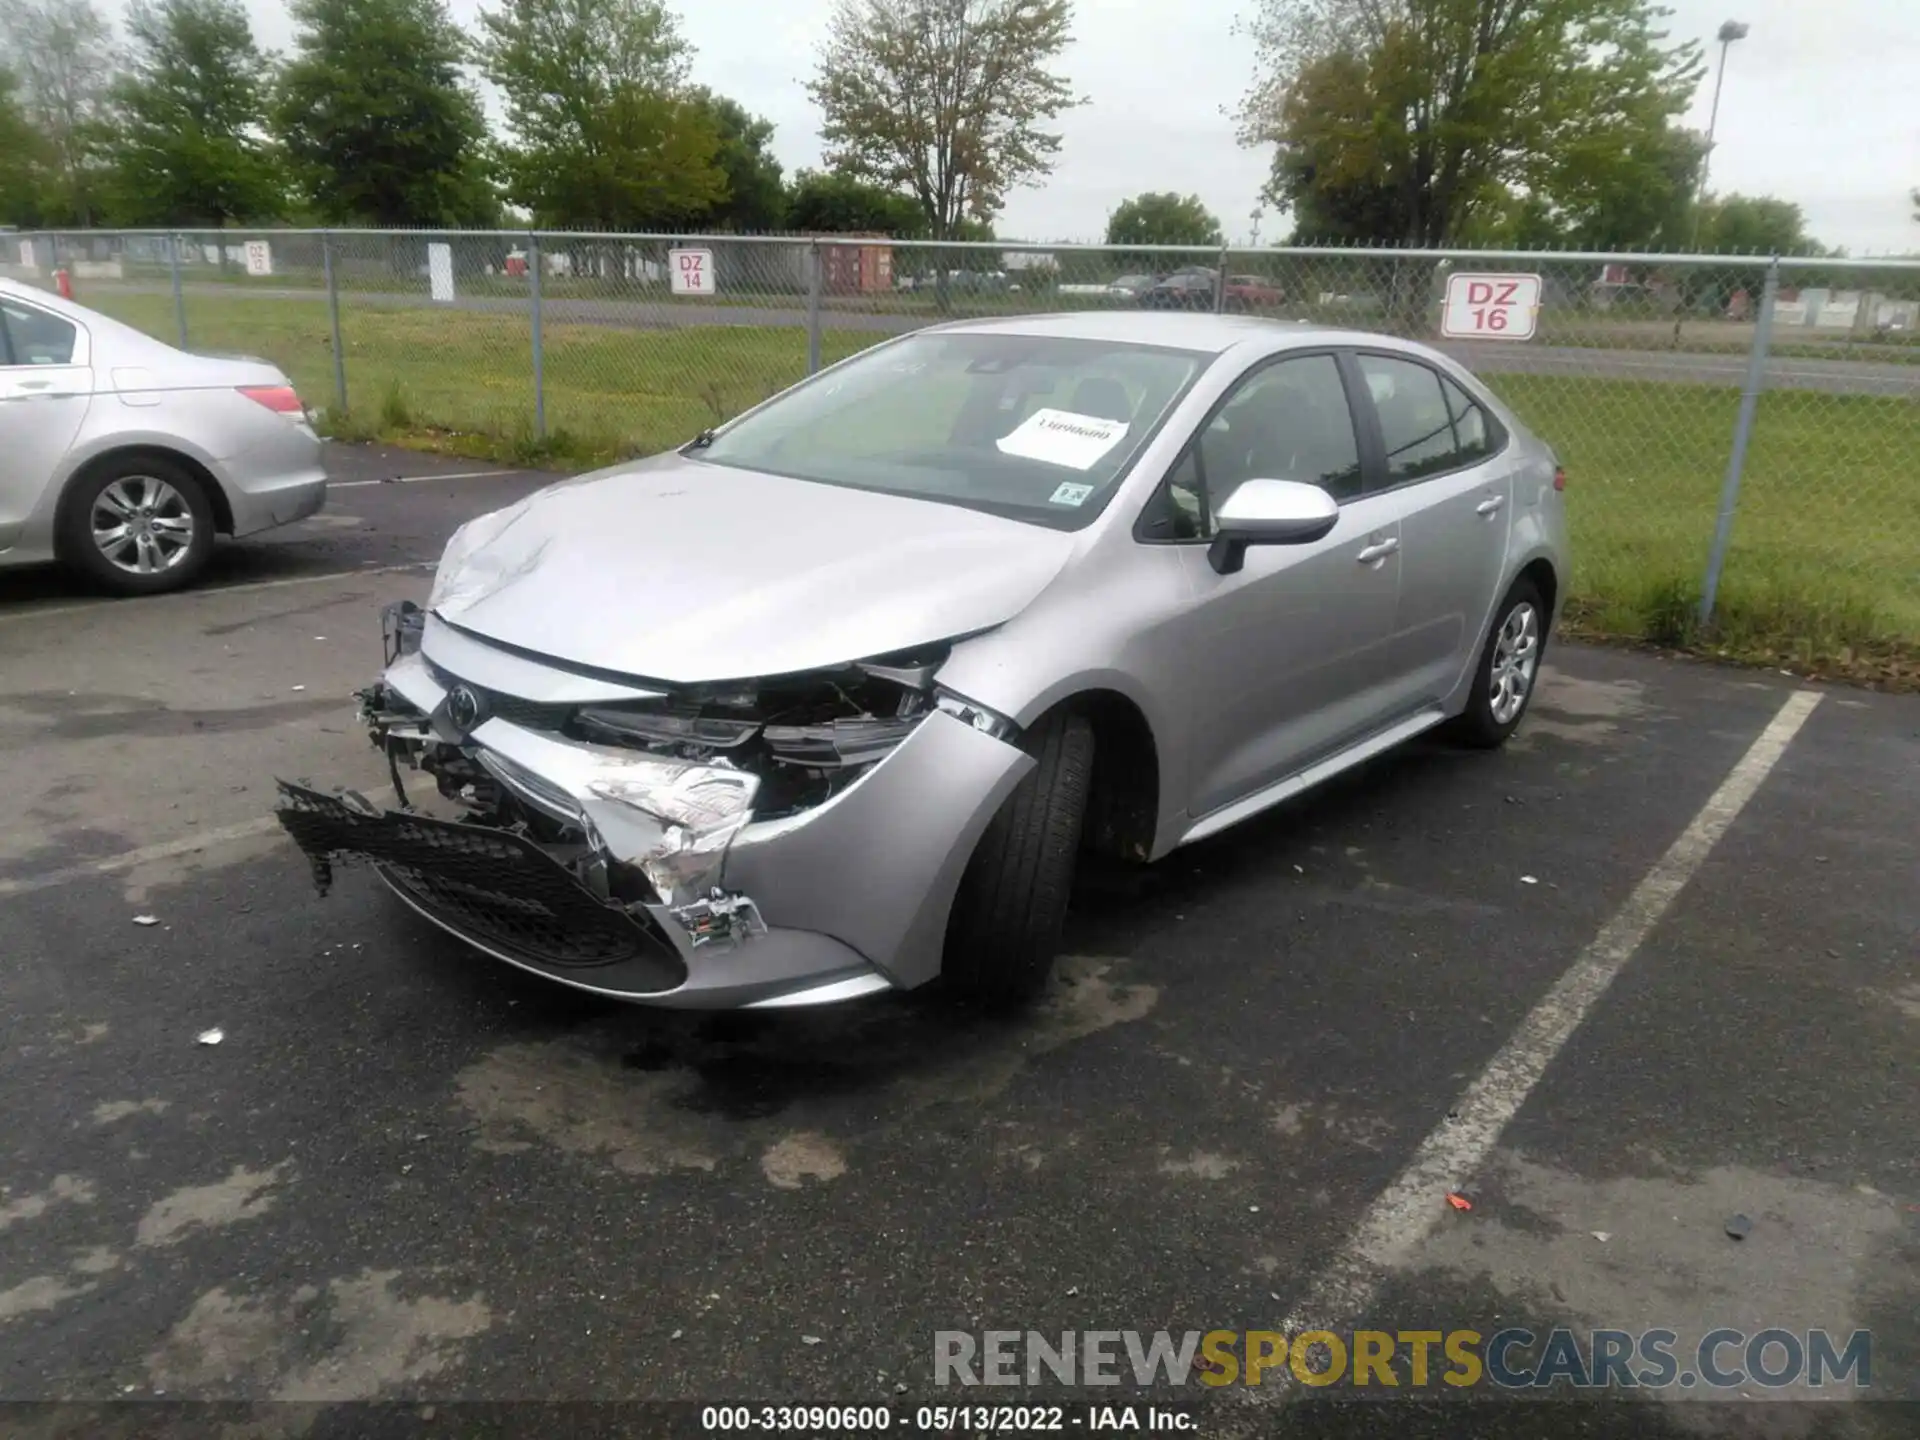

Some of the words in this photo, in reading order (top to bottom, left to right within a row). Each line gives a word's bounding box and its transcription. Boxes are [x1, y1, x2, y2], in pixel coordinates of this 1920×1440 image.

[250, 246, 264, 257] DZ
[680, 255, 703, 271] DZ
[684, 273, 701, 288] 14
[1467, 282, 1519, 305] DZ
[1472, 308, 1508, 331] 16
